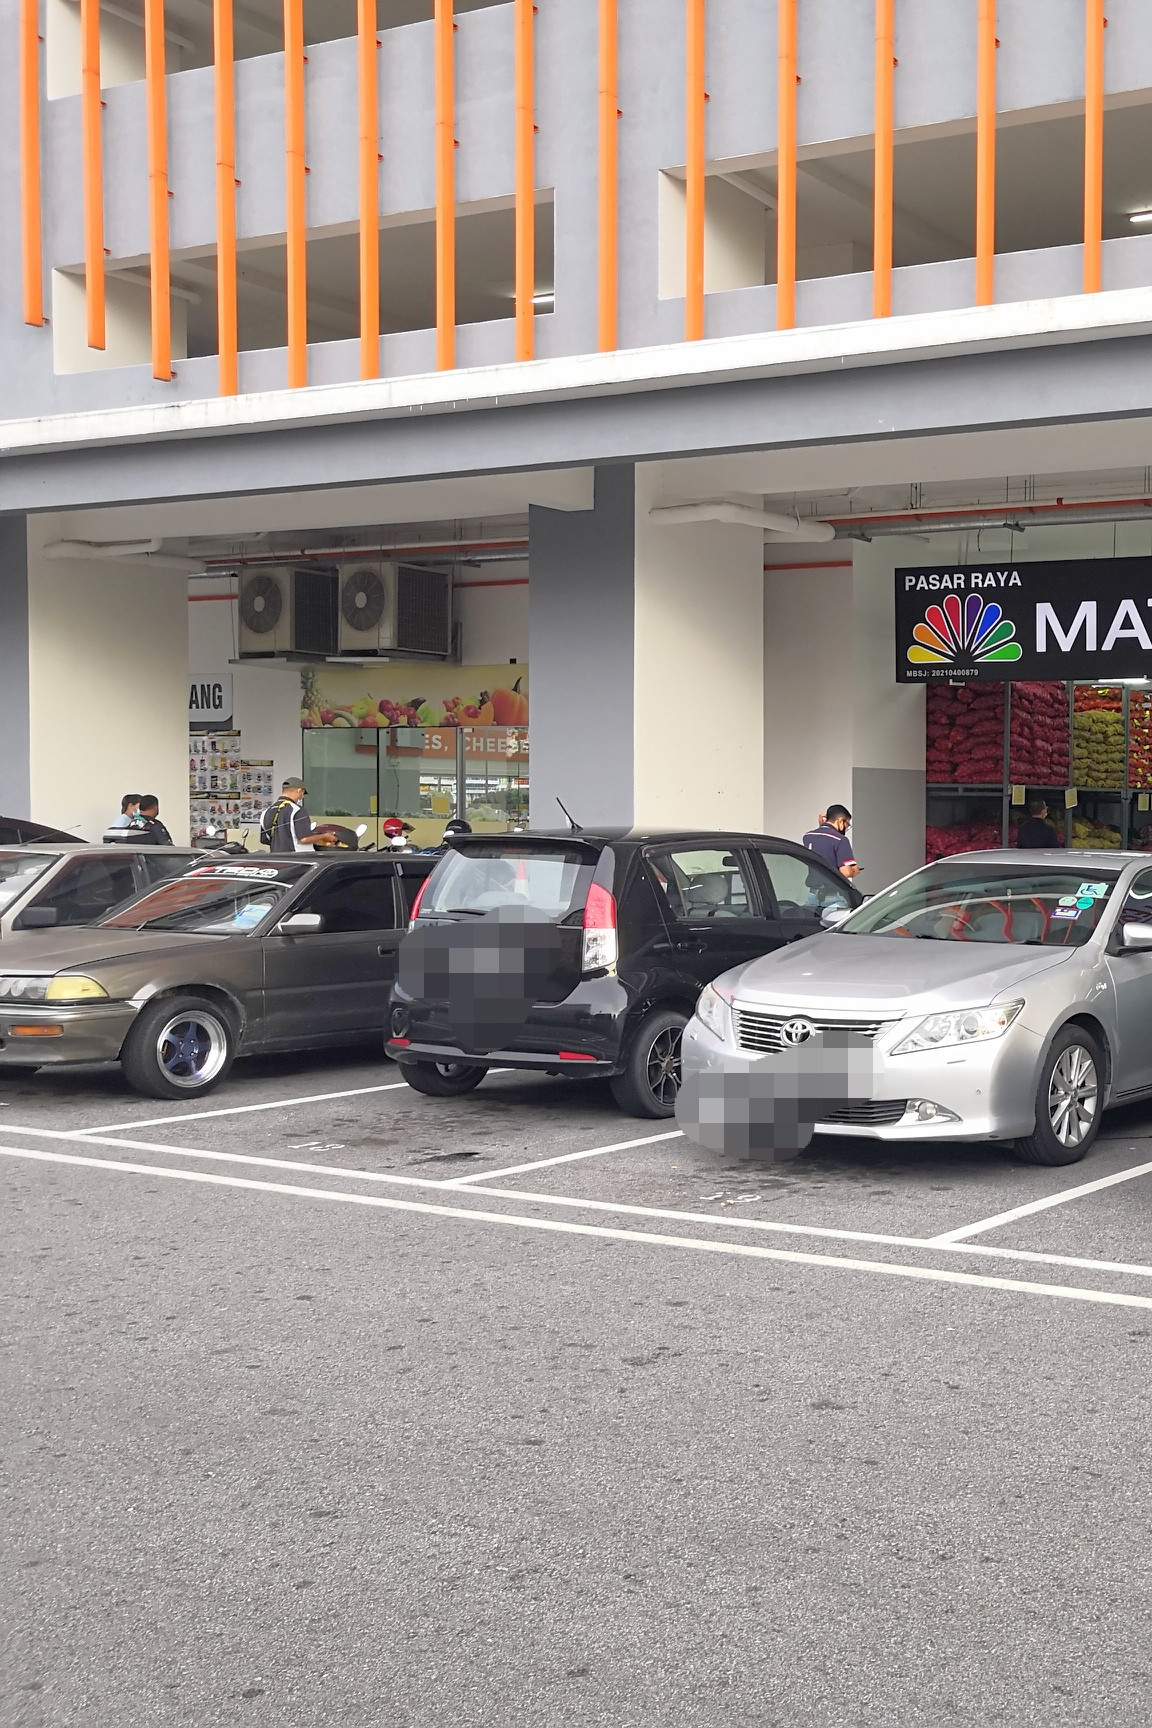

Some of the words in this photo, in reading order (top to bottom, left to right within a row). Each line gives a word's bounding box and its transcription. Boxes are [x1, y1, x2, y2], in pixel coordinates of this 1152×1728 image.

[905, 573, 965, 591] PASAR
[971, 571, 1023, 588] RAYA
[906, 670, 930, 678] MBSJ:
[931, 668, 979, 677] 20210400879
[188, 683, 223, 710] ANG
